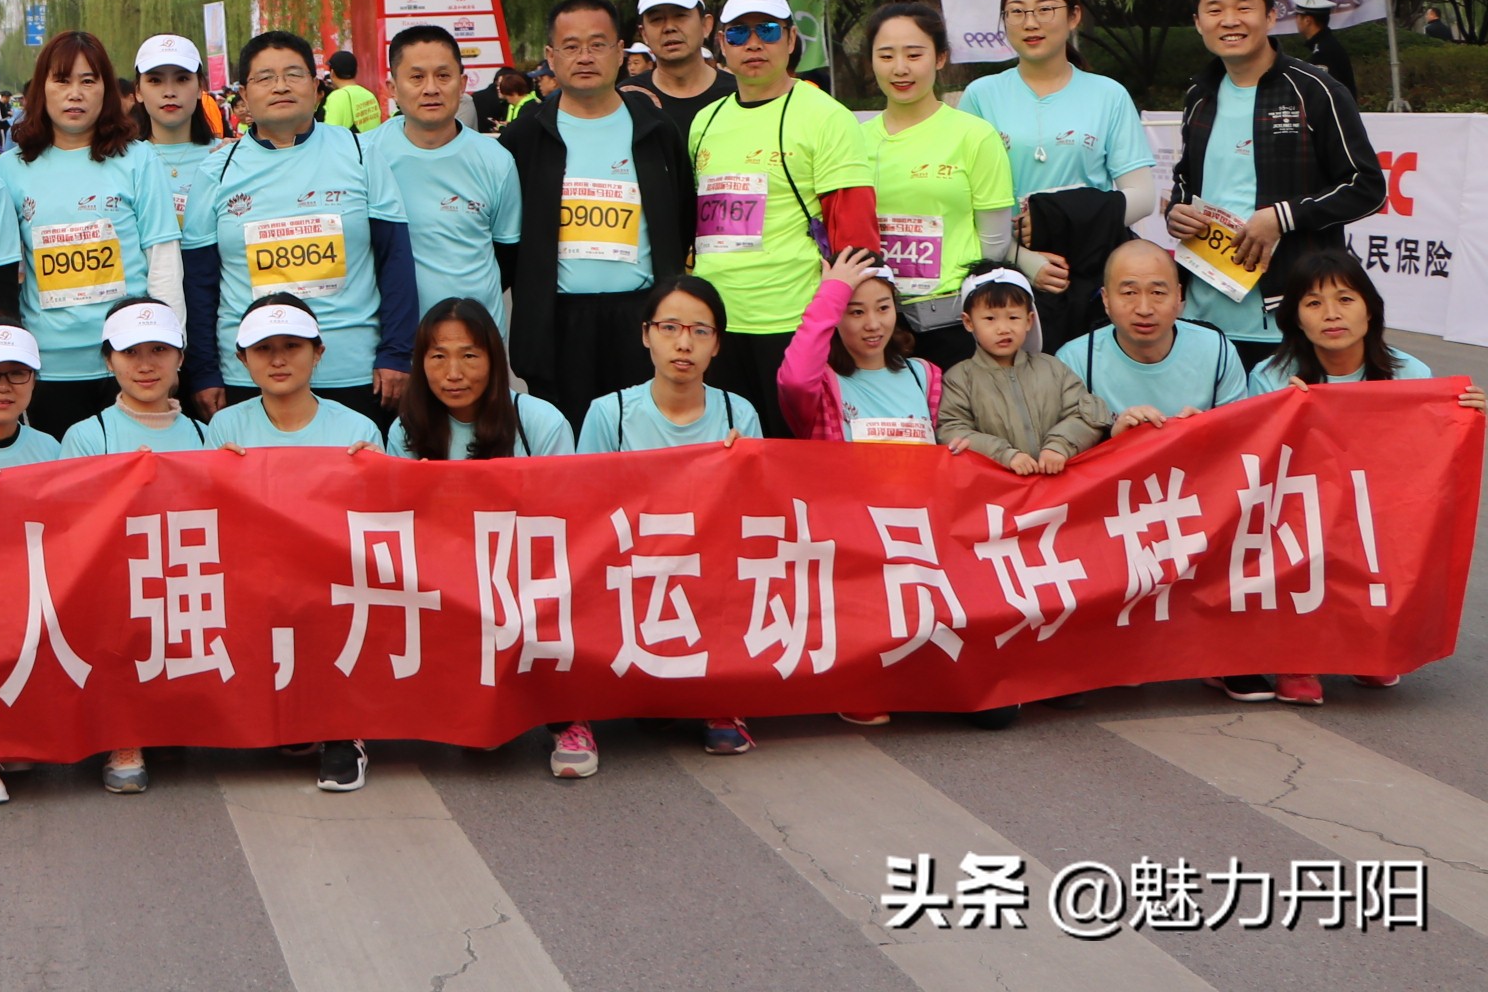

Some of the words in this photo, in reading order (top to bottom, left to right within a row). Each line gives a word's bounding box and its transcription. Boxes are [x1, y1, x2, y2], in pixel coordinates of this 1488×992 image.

[560, 205, 633, 230] D9007
[698, 199, 758, 222] C7167
[41, 246, 115, 277] D9052
[256, 241, 338, 271] D8964
